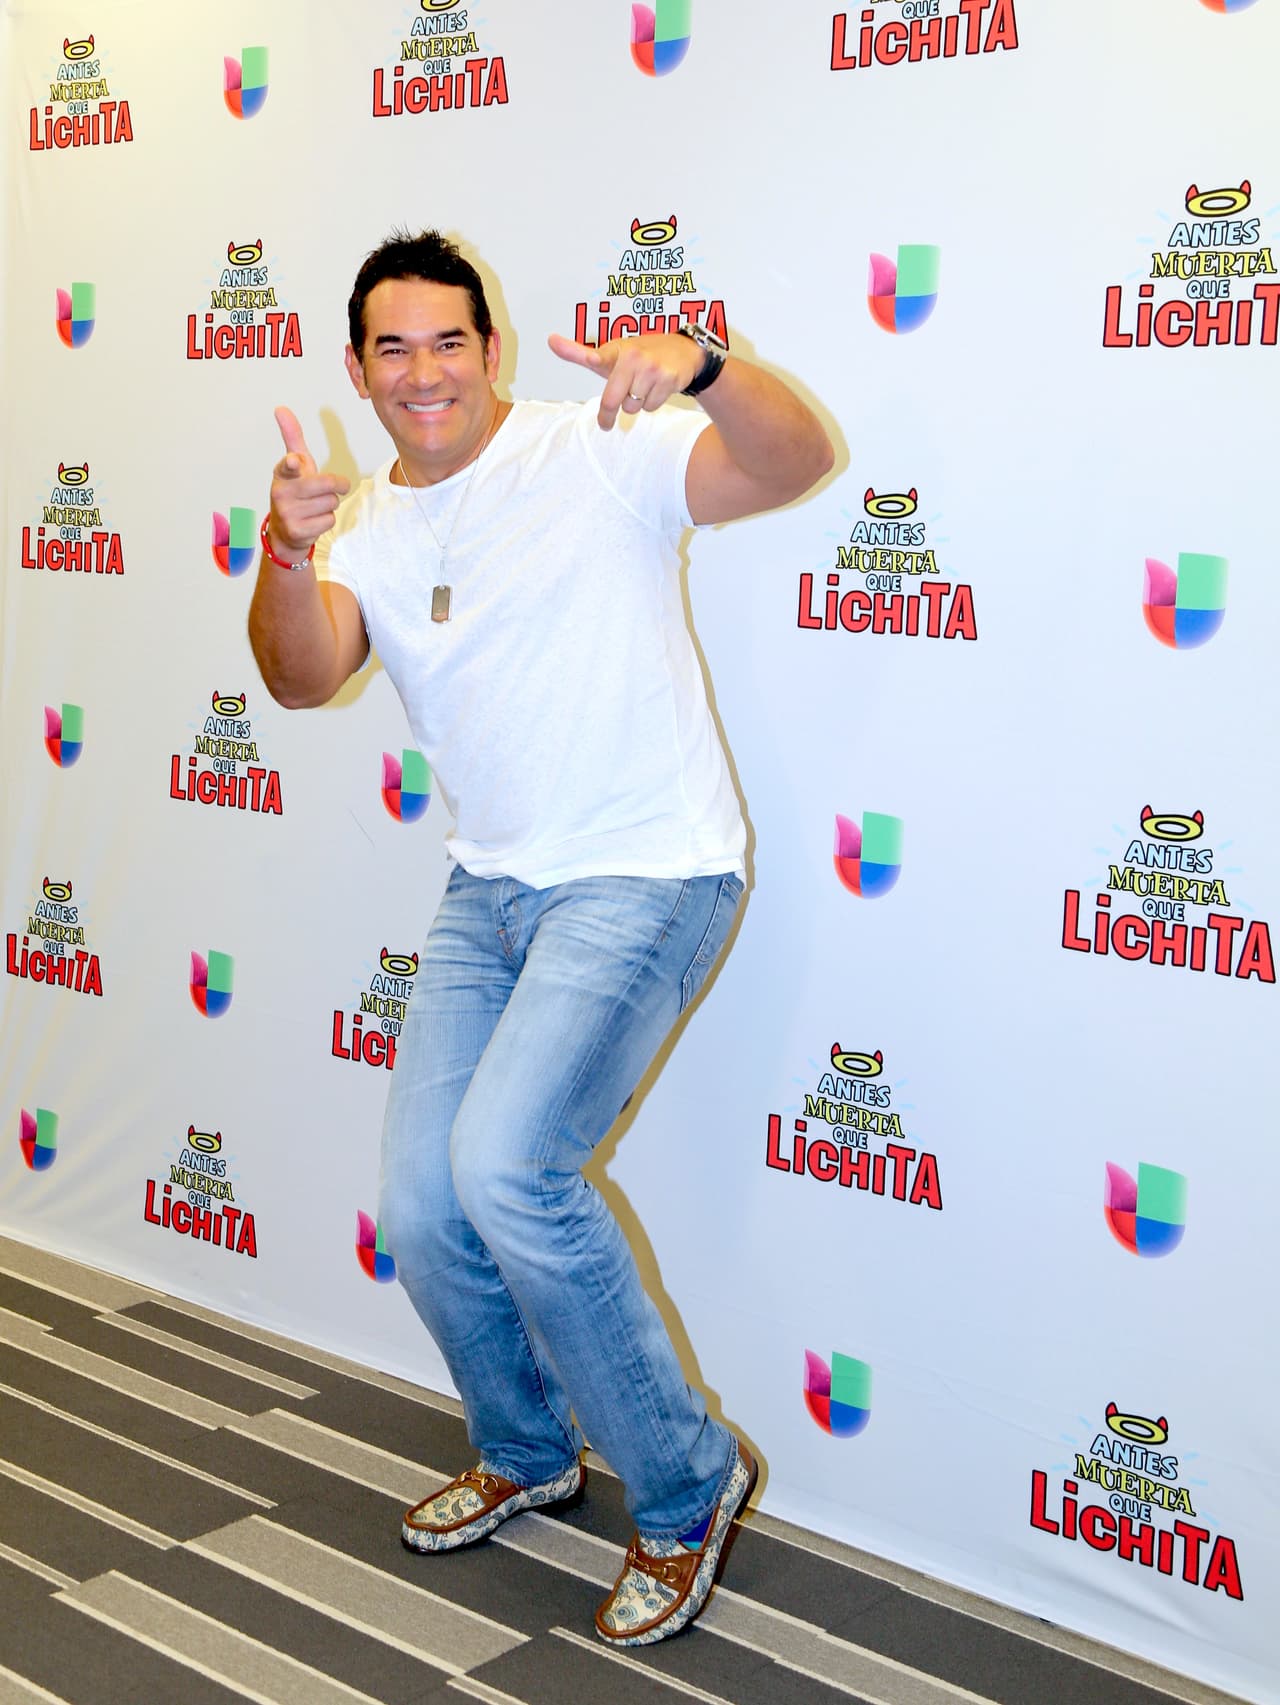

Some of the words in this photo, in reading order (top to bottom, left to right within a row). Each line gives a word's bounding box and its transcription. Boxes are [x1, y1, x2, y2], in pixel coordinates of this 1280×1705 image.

[411, 10, 467, 36] ANTES
[902, 0, 939, 19] QUE
[400, 32, 479, 60] MUERTA
[831, 0, 1018, 70] LiCHITA
[57, 60, 100, 80] ANTES
[424, 59, 450, 75] QUE
[50, 79, 110, 102] MUERTA
[373, 57, 508, 117] LiCHITA
[67, 101, 88, 115] QUE
[30, 101, 133, 150] LiCHITA
[1168, 218, 1260, 248] ANTES
[619, 247, 684, 270] ANTES
[1150, 248, 1277, 280] MUERTA
[220, 266, 268, 287] ANTES
[607, 271, 696, 298] MUERTA
[1186, 280, 1230, 299] QUE
[211, 288, 277, 311] MUERTA
[633, 298, 664, 314] QUE
[231, 310, 253, 324] QUE
[187, 313, 302, 359] LiCHITA
[50, 487, 93, 506] ANTES
[43, 506, 102, 527] MUERTA
[60, 526, 81, 540] QUE
[850, 521, 925, 546] ANTES
[21, 526, 124, 575] LiCHITA
[836, 546, 940, 575] MUERTA
[866, 574, 901, 592] QUE
[797, 573, 977, 640] LiCHITA
[203, 716, 250, 738] ANTES
[194, 735, 260, 761] MUERTA
[213, 758, 236, 774] QUE
[170, 754, 283, 815] LiCHITA
[1124, 840, 1213, 873] ANTES
[1107, 865, 1230, 906] MUERTA
[35, 900, 78, 923] ANTES
[1142, 898, 1185, 921] QUE
[27, 917, 85, 945] MUERTA
[1062, 889, 1276, 983] LiCHITA
[43, 940, 65, 955] QUE
[6, 933, 103, 997] LiCHITA
[817, 1073, 891, 1108] ANTES
[803, 1094, 905, 1139] MUERTA
[833, 1126, 868, 1150] QUE
[179, 1149, 226, 1177] ANTES
[766, 1113, 943, 1210] LiCHITA
[170, 1165, 234, 1202] MUERTA
[187, 1191, 211, 1209] QUE
[144, 1179, 257, 1259] LiCHITA
[1090, 1434, 1178, 1480] ANTES
[1073, 1453, 1197, 1517] MUERTA
[1109, 1494, 1151, 1522] QUE
[1030, 1469, 1244, 1601] LiCHITA
